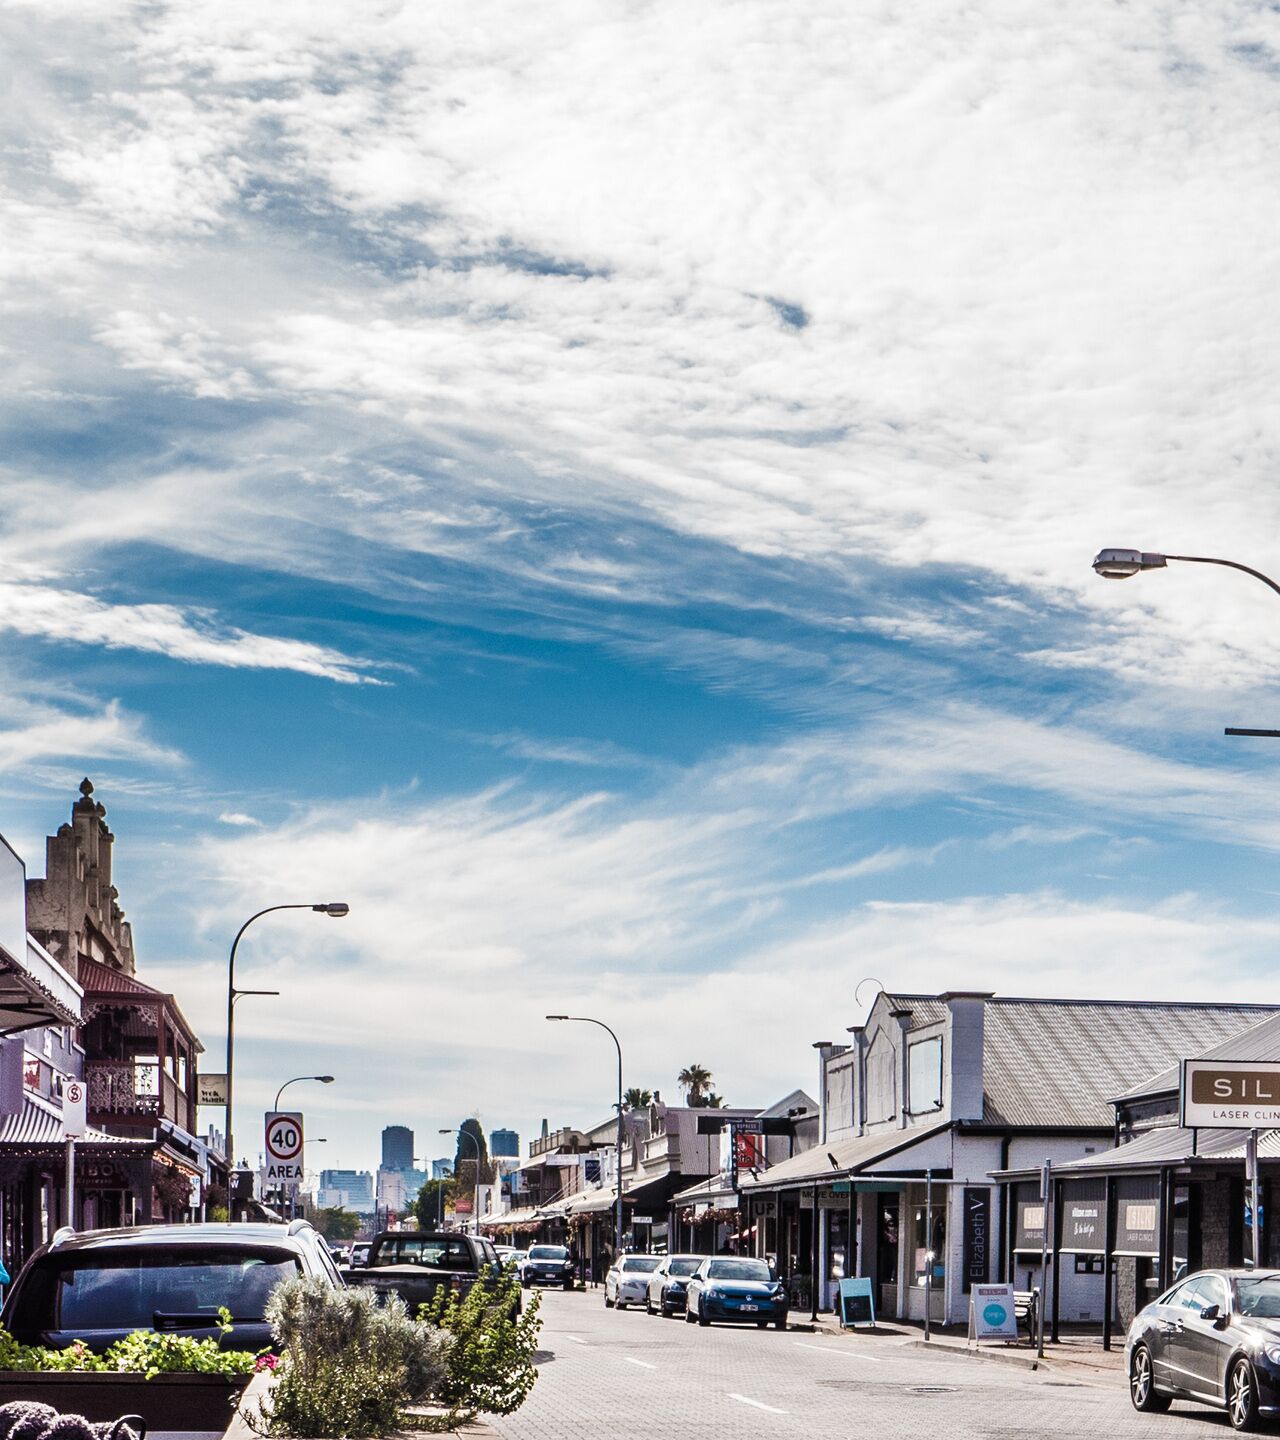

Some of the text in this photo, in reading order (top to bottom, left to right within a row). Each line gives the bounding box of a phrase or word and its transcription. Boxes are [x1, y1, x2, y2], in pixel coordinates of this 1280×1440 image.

[1213, 1110, 1249, 1119] LASER
[272, 1129, 297, 1148] 40
[268, 1165, 304, 1178] AREA
[970, 1213, 985, 1278] Elizabeth
